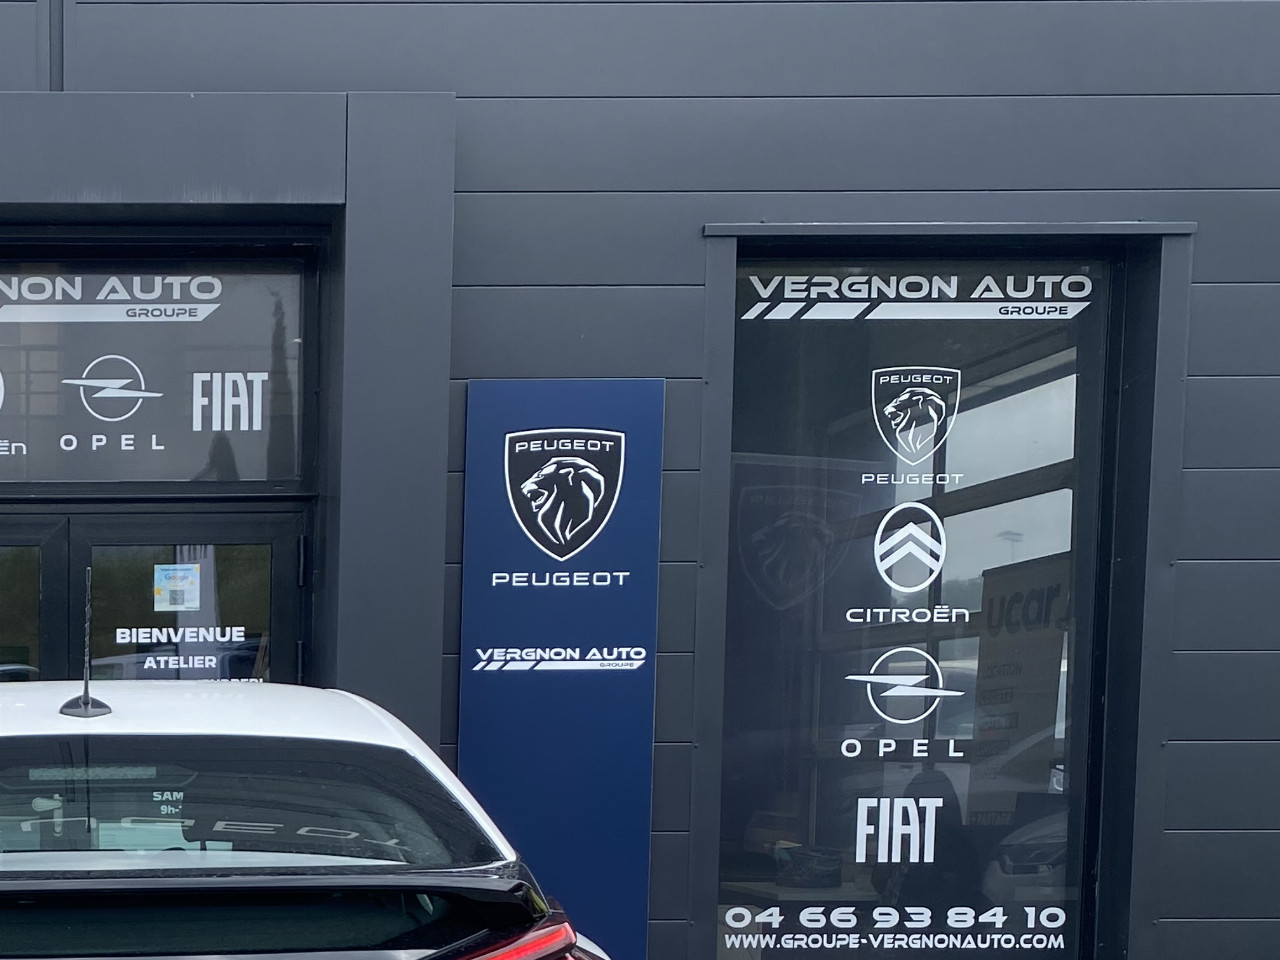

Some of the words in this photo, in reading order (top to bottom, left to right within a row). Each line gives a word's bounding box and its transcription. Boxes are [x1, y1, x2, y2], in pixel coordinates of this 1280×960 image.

[96, 276, 222, 301] AUTO
[749, 275, 958, 299] VERGNON
[970, 275, 1093, 299] AUTO
[125, 307, 198, 318] GROUPE
[998, 305, 1069, 316] GROUPE
[879, 374, 953, 385] PEUGEOT
[193, 372, 269, 432] FIAT
[60, 434, 165, 451] OPEL
[515, 439, 614, 453] PEUGEOT
[861, 473, 964, 485] PEUGEOT
[492, 571, 630, 587] PEUGEOT
[115, 626, 246, 644] BIENVENUE
[143, 655, 217, 669] ATELIER
[475, 647, 580, 660] VERGNON
[584, 647, 647, 661] AUTO
[840, 737, 966, 758] OPEL
[855, 797, 944, 863] FIAT
[724, 906, 785, 929] 04
[798, 906, 858, 929] 66
[872, 906, 932, 929] 93
[946, 906, 1008, 929] 84
[1023, 906, 1066, 929] 10
[724, 933, 1065, 950] WWW.GROUPE-VERGNONAUTO.COM
